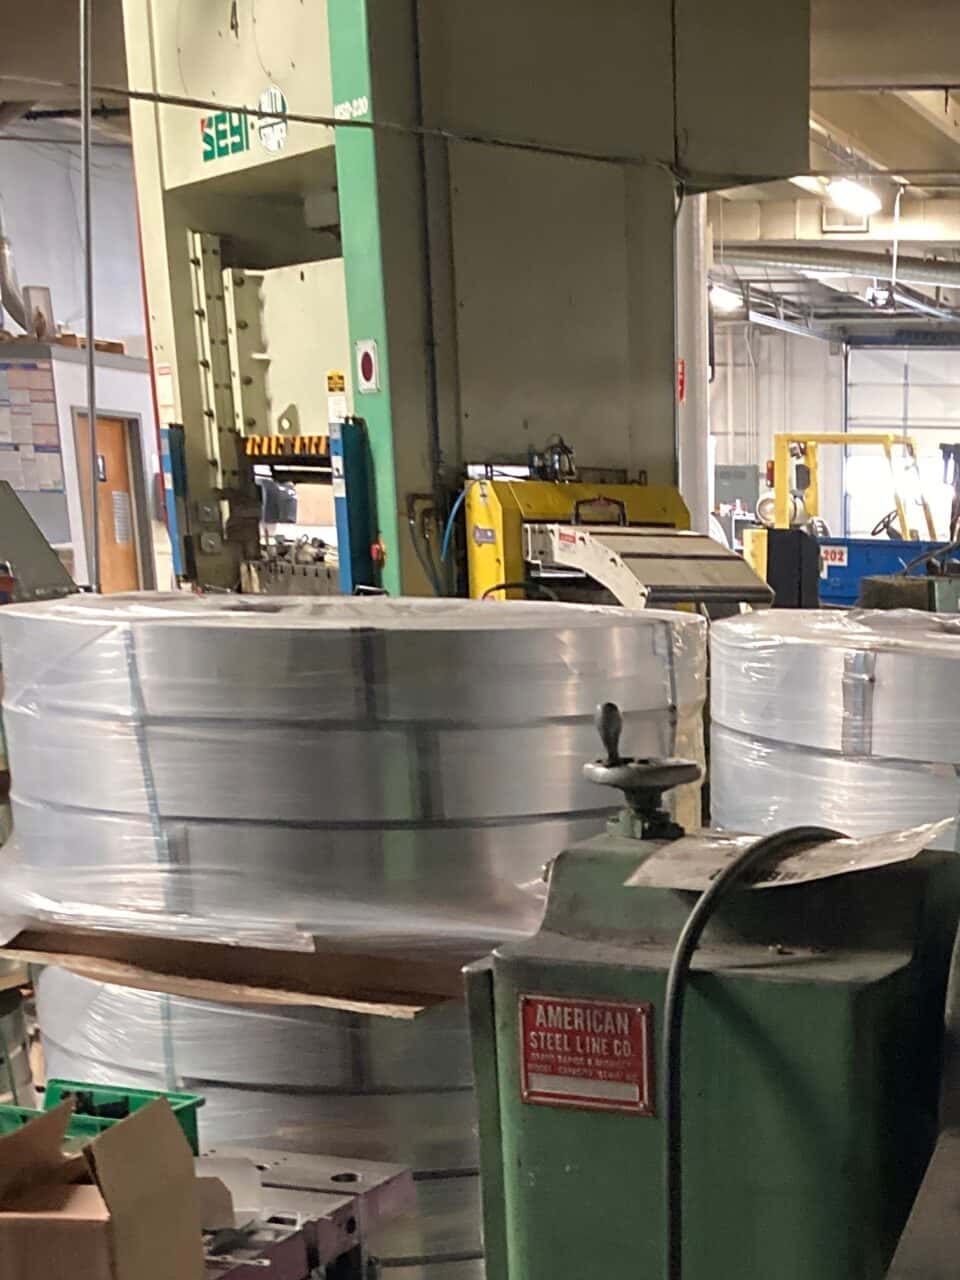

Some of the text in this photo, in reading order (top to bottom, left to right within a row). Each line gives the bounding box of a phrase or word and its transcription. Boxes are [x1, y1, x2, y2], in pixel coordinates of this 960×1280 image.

[823, 549, 844, 562] 202
[536, 1004, 629, 1035] AMERICAN
[529, 1031, 571, 1052] STEEL
[576, 1035, 608, 1056] LINE
